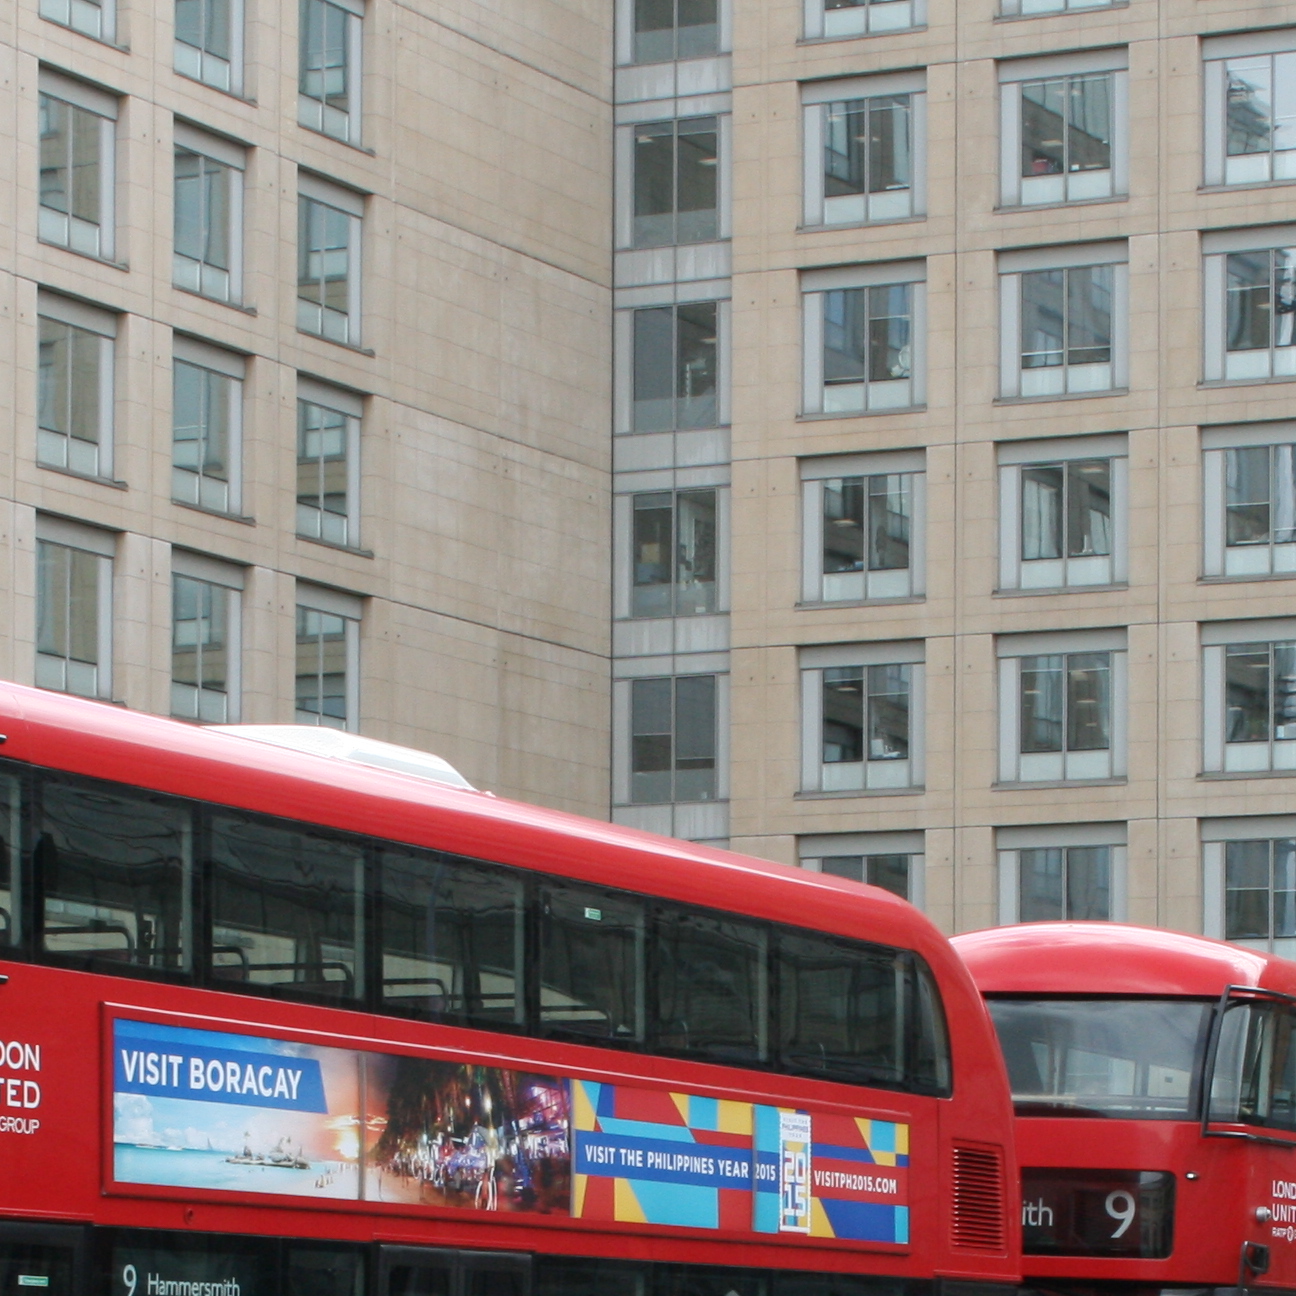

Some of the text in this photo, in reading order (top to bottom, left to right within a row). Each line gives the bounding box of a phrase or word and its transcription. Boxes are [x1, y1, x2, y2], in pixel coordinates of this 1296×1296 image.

[121, 1049, 302, 1100] VISIT BORACAY
[585, 1144, 777, 1182] VISIT THE PHILIPPINES YEAR 2015
[814, 1169, 898, 1195] VISITPH2015.COM
[1105, 1189, 1136, 1239] 9
